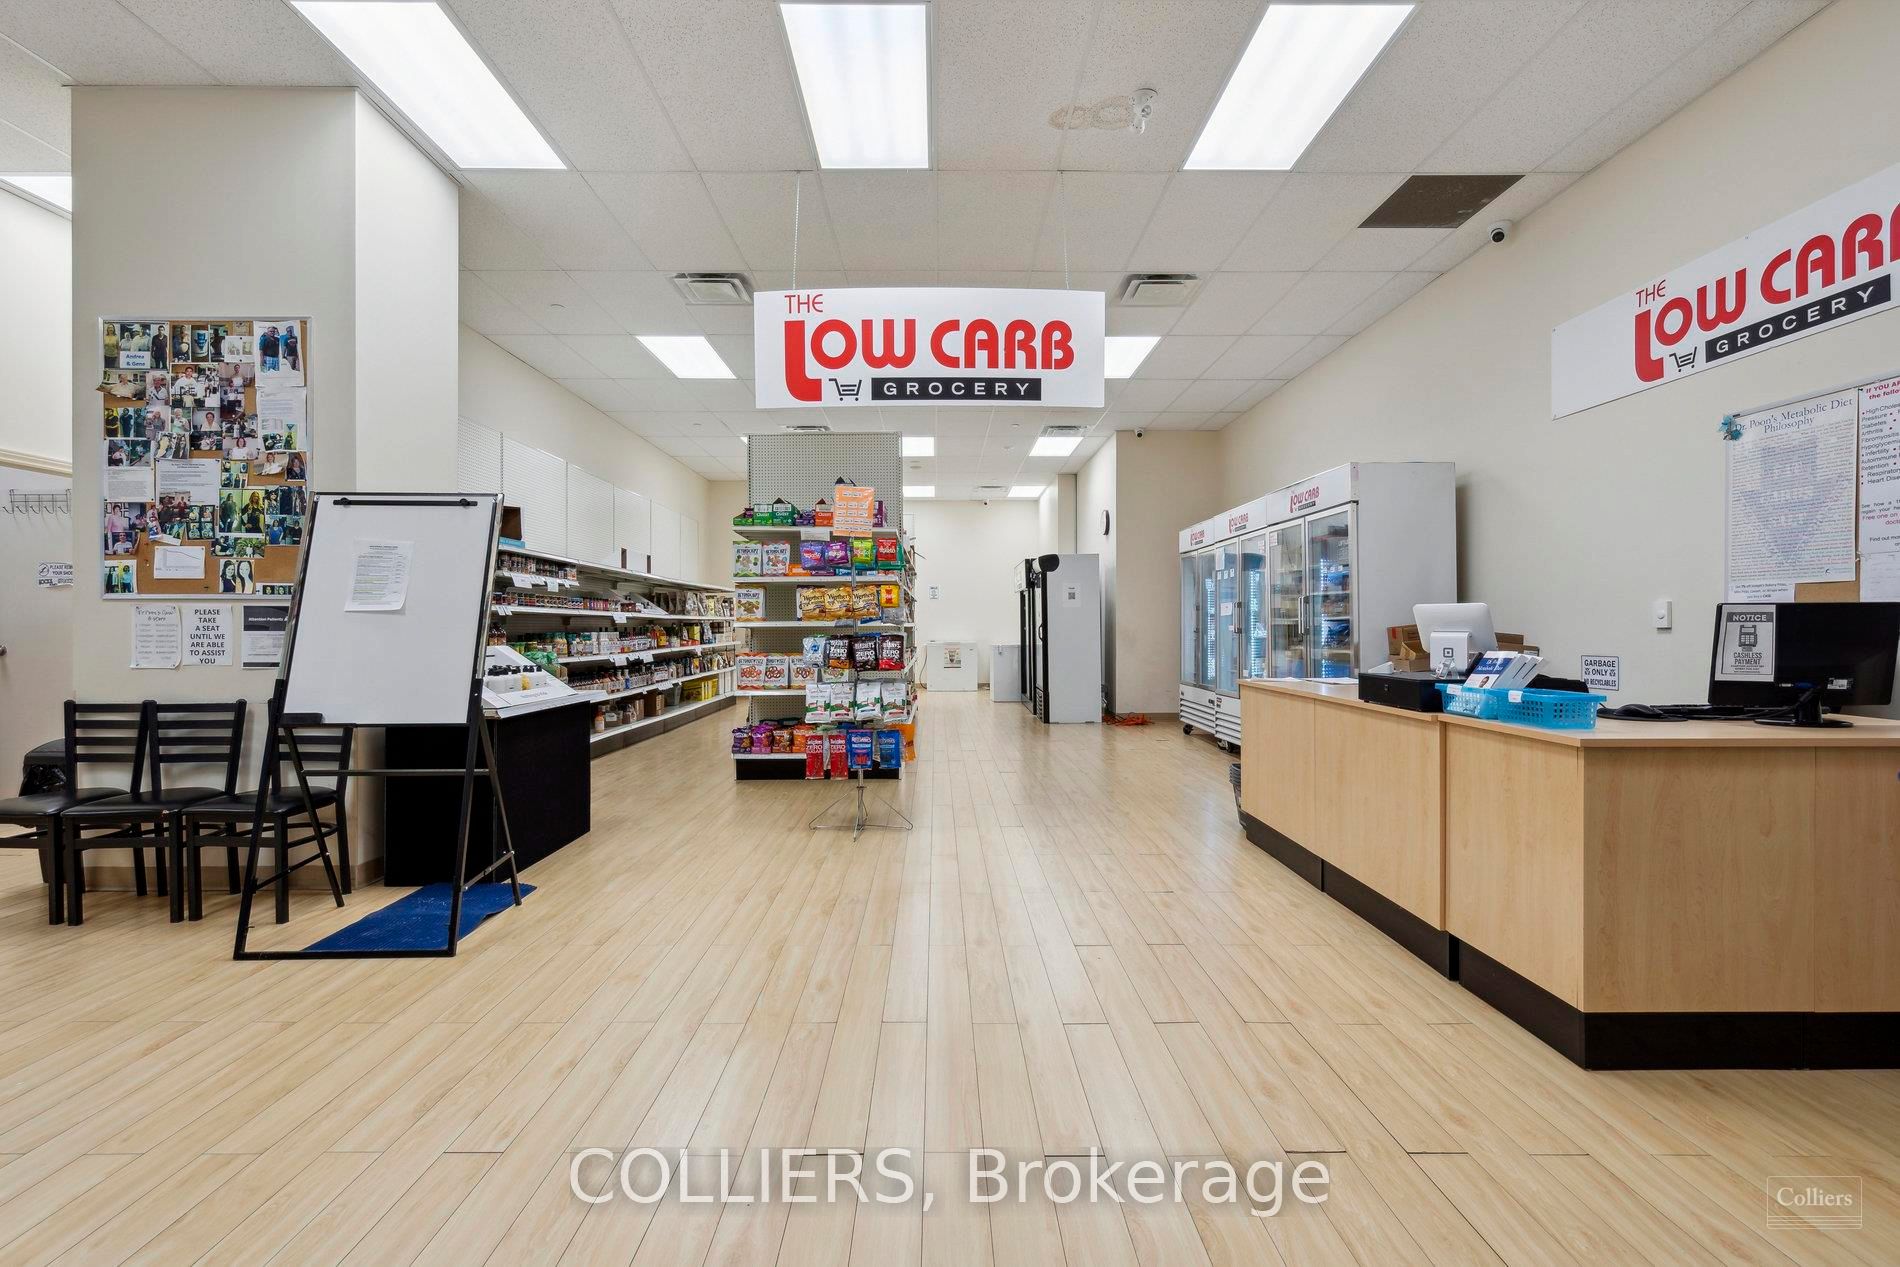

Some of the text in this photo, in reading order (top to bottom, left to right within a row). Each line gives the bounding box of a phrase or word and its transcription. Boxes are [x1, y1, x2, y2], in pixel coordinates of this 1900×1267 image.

[1635, 201, 1900, 383] LOW CAR
[1635, 279, 1666, 308] THE
[784, 293, 824, 314] THE
[1716, 286, 1875, 354] GROCERY
[784, 319, 1075, 402] LOW CARB
[883, 382, 1030, 396] GROCERY
[1873, 383, 1889, 391] YOU
[1749, 414, 1777, 428] Poon's
[1780, 403, 1827, 422] Metabolic
[1830, 398, 1853, 410] Diet
[1763, 416, 1815, 434] Philosophy
[1305, 485, 1320, 502] CARB
[1732, 614, 1767, 622] NOTICE
[199, 657, 216, 665] YOU
[1584, 659, 1616, 668] GARBAGE
[1591, 668, 1608, 676] ONLY
